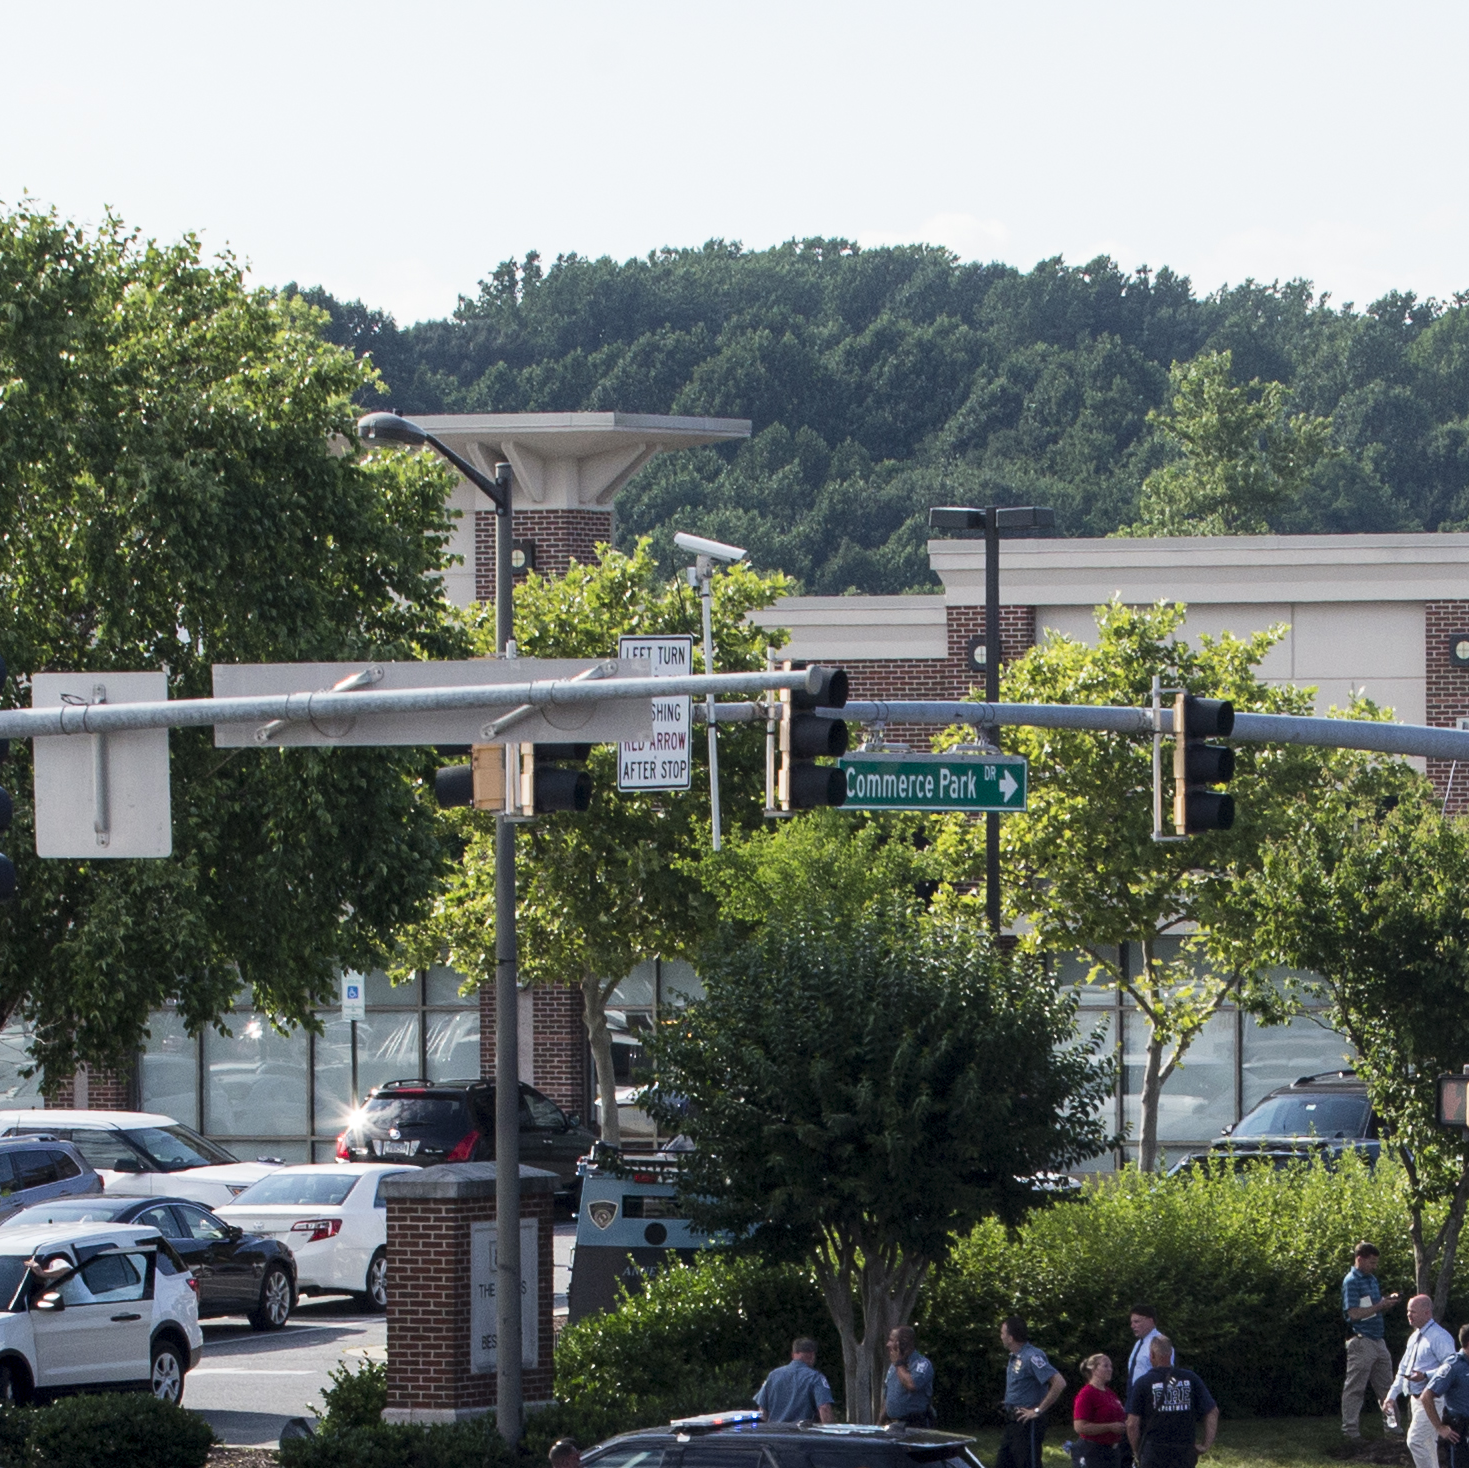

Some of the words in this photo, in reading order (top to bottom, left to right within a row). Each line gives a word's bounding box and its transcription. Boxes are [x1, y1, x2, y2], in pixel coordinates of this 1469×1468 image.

[658, 646, 685, 665] TURN
[650, 732, 687, 752] ARROW
[623, 761, 657, 780] AFTER
[661, 760, 687, 780] STOP
[846, 767, 933, 799] Commerce
[939, 769, 977, 799] Park
[984, 766, 997, 781] DR
[479, 1284, 496, 1298] THE
